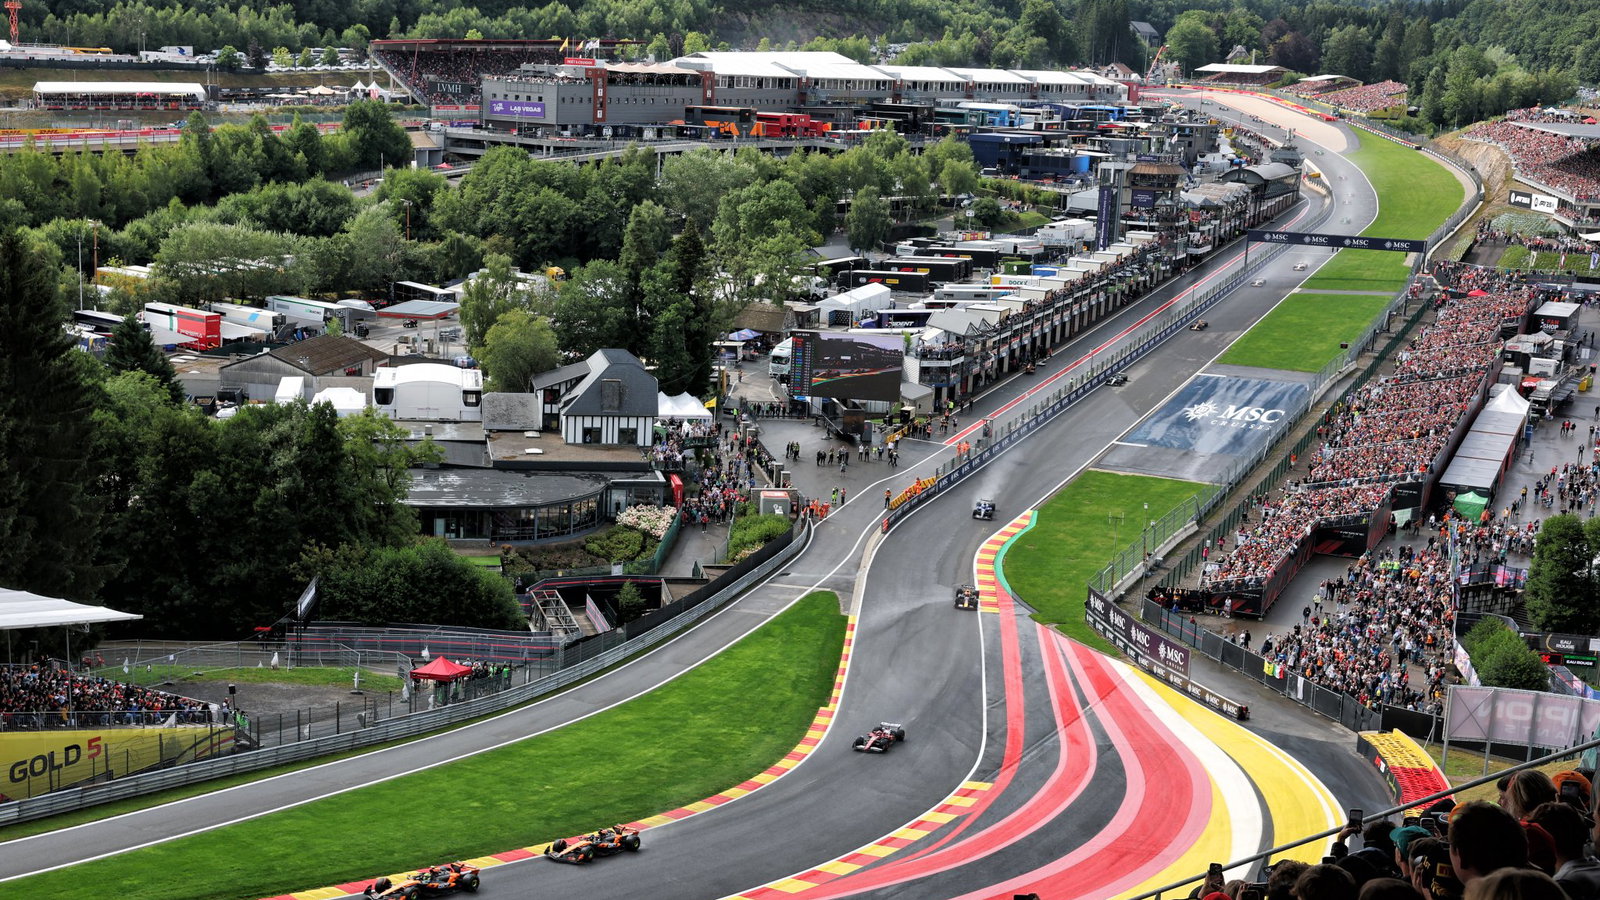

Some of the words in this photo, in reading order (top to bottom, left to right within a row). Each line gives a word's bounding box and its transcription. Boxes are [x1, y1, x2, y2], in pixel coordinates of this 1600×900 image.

[437, 83, 462, 93] LVMH
[1218, 405, 1285, 423] MSC
[1210, 420, 1272, 431] CRUISES
[1094, 596, 1104, 615] MSC
[1114, 614, 1126, 630] MSC
[1136, 629, 1150, 647] MSC
[1166, 646, 1184, 665] MSC
[1156, 666, 1165, 676] MSC
[1173, 674, 1182, 686] MSC
[1191, 685, 1201, 696] MSC
[1209, 694, 1219, 706] MSC
[1227, 703, 1237, 714] MSC
[10, 744, 81, 783] GOLD
[88, 736, 101, 759] 5
